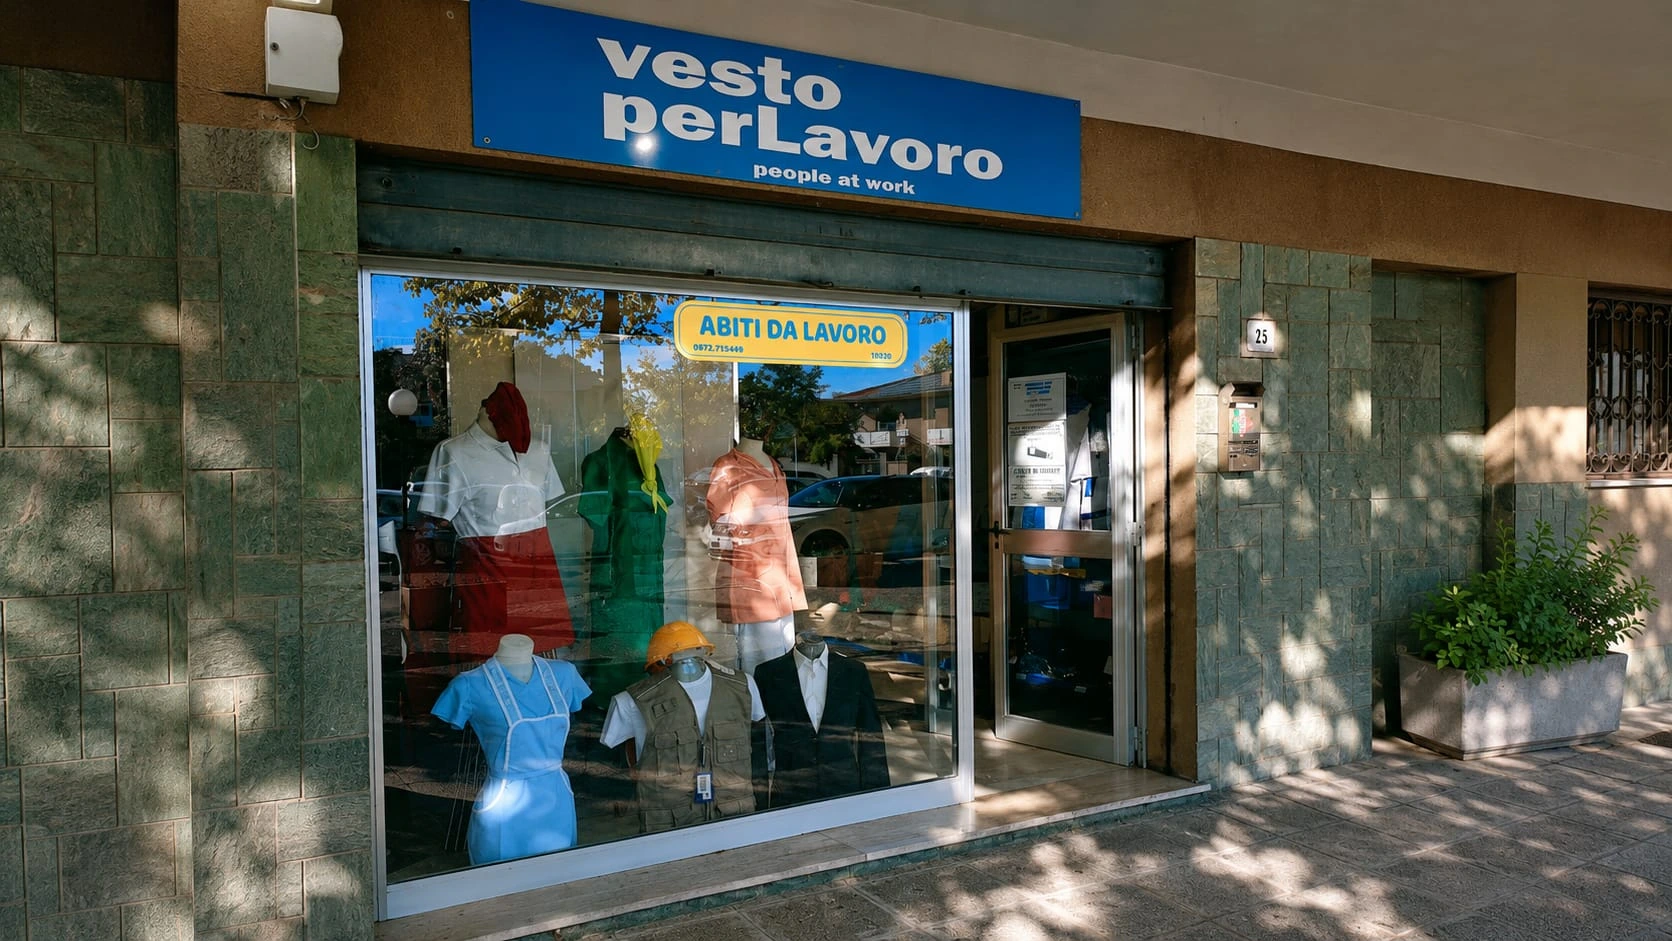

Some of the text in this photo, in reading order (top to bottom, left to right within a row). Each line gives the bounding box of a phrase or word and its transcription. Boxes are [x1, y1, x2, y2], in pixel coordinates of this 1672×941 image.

[597, 37, 841, 111] vesto
[603, 92, 1003, 181] perLavoro
[753, 164, 915, 195] people at work
[700, 315, 887, 345] ABITI DA LAVORO
[1255, 329, 1268, 344] 25
